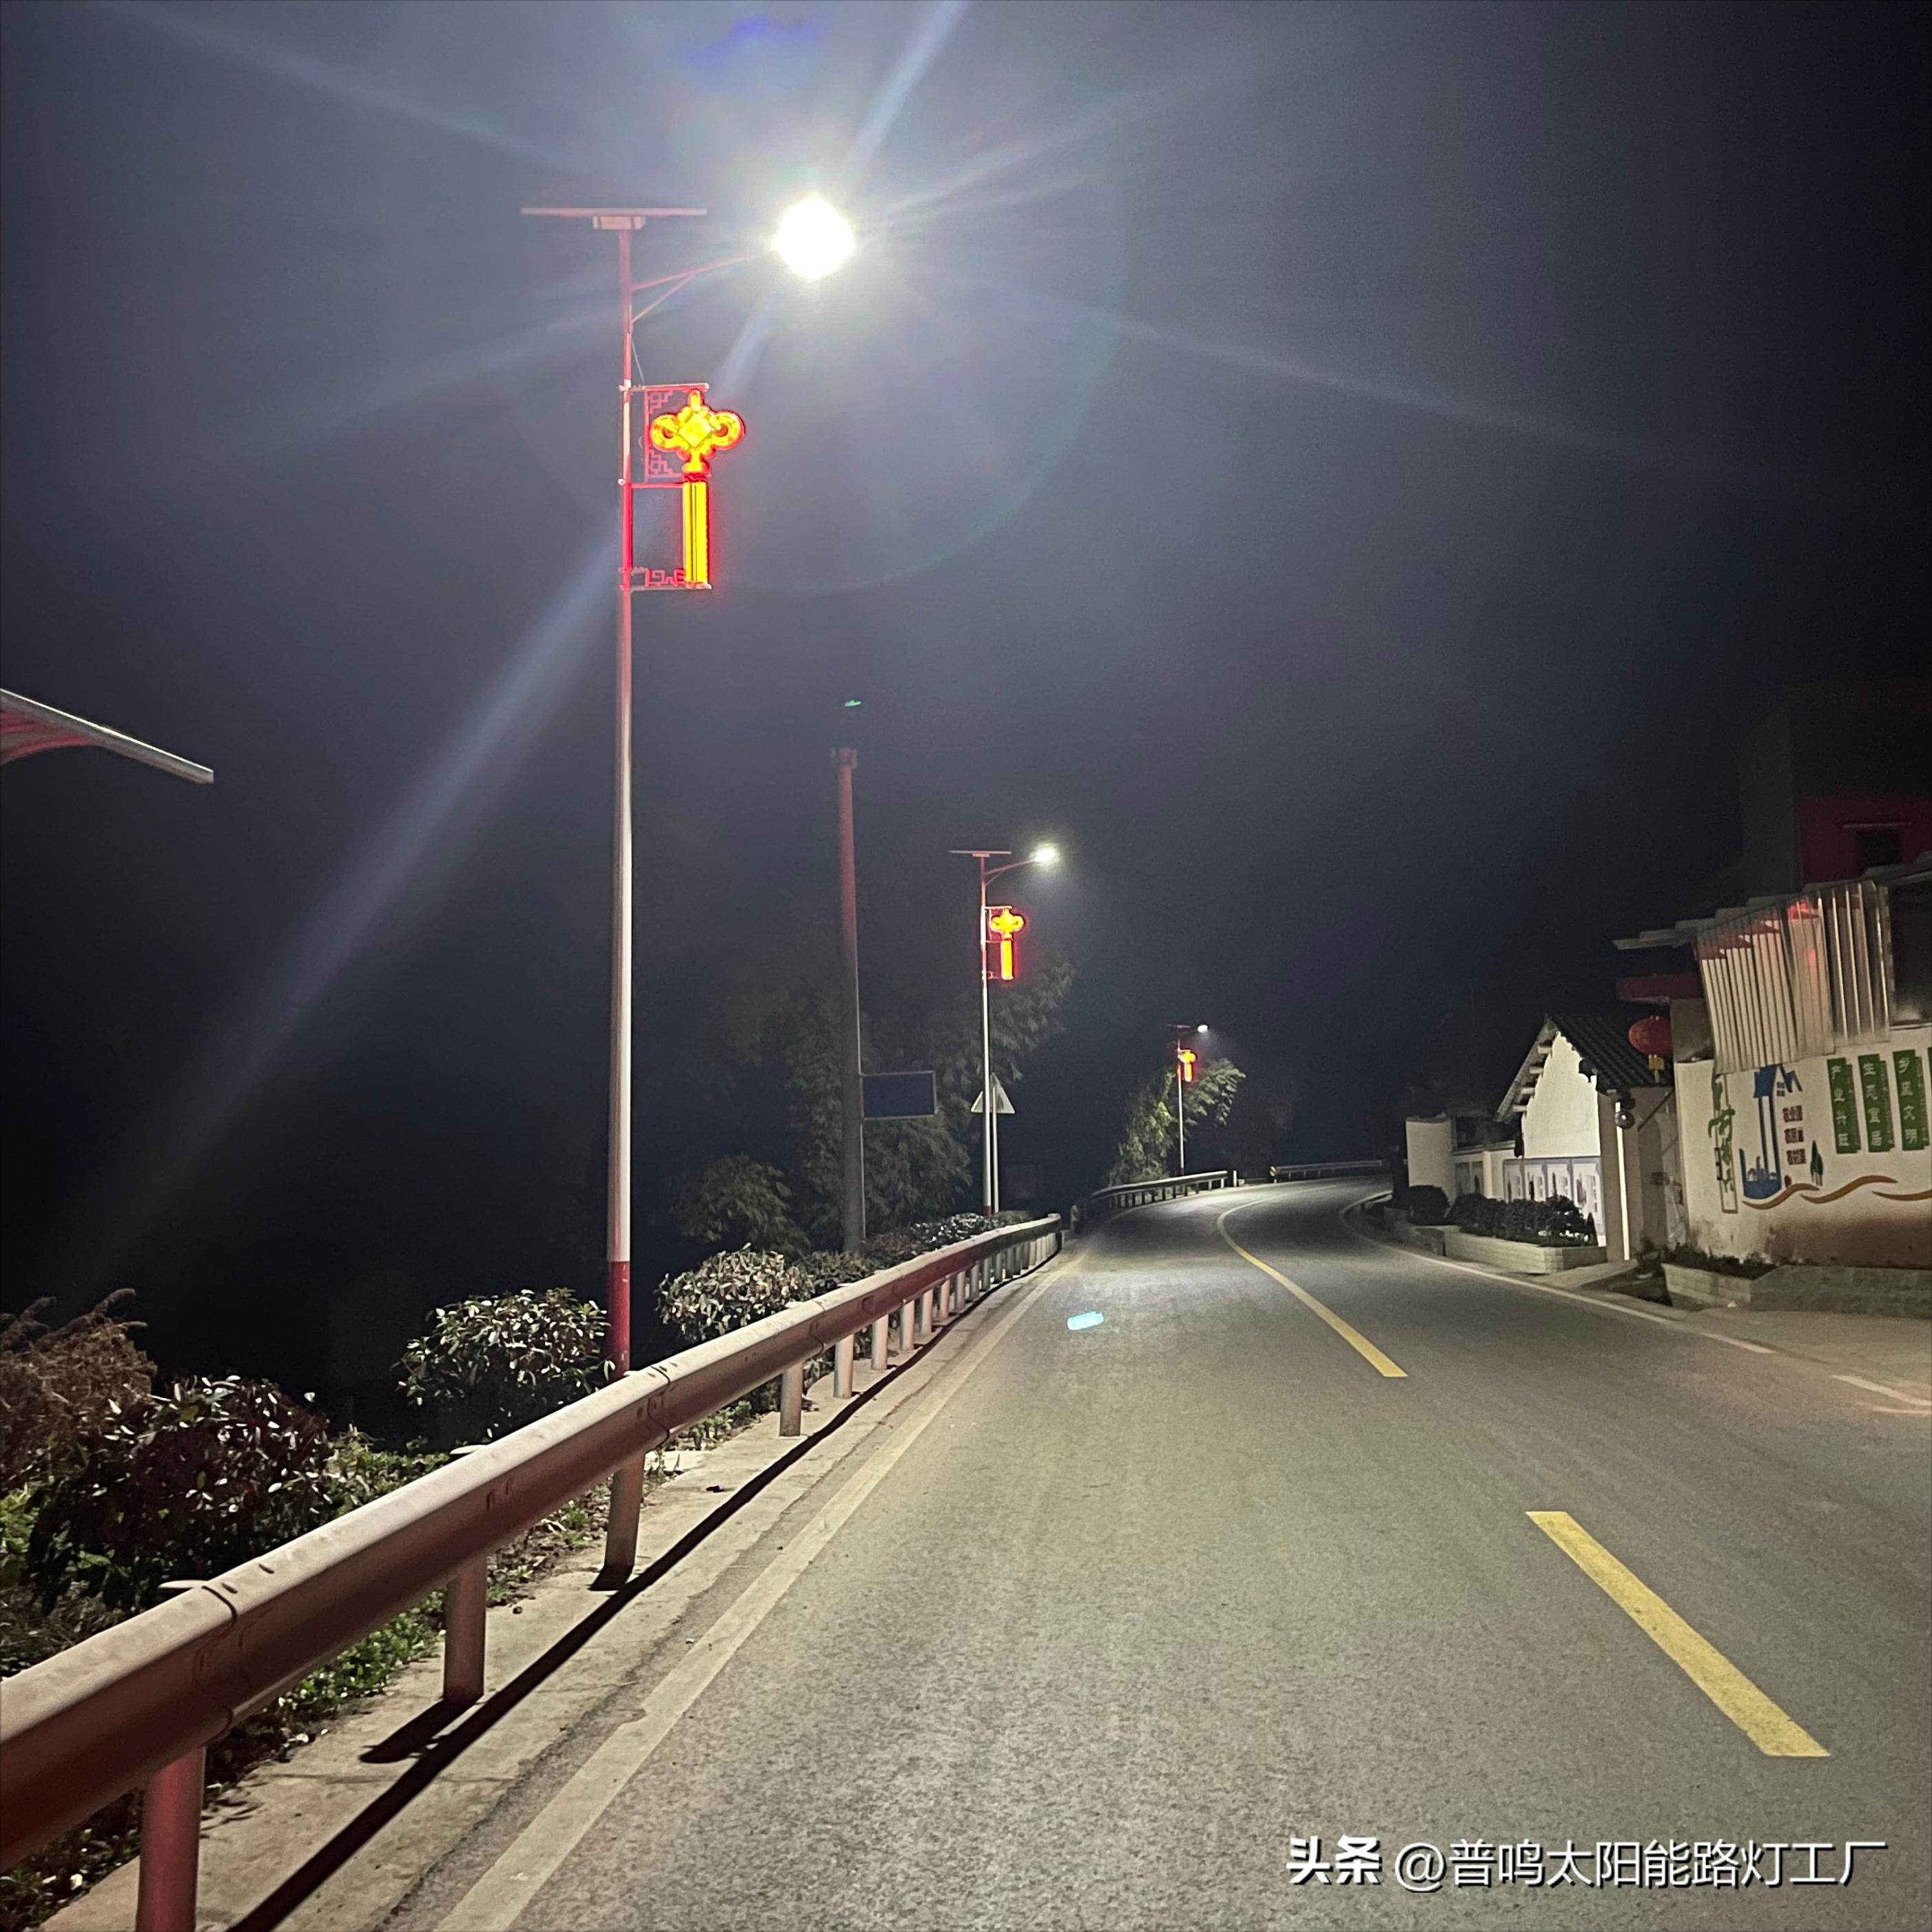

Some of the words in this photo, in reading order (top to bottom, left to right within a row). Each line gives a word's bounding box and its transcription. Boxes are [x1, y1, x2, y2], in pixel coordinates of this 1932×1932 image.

[1830, 1065, 1850, 1147] 产业兴旺
[1862, 1062, 1883, 1147] 生态宜居
[1898, 1056, 1918, 1144] 乡风文明
